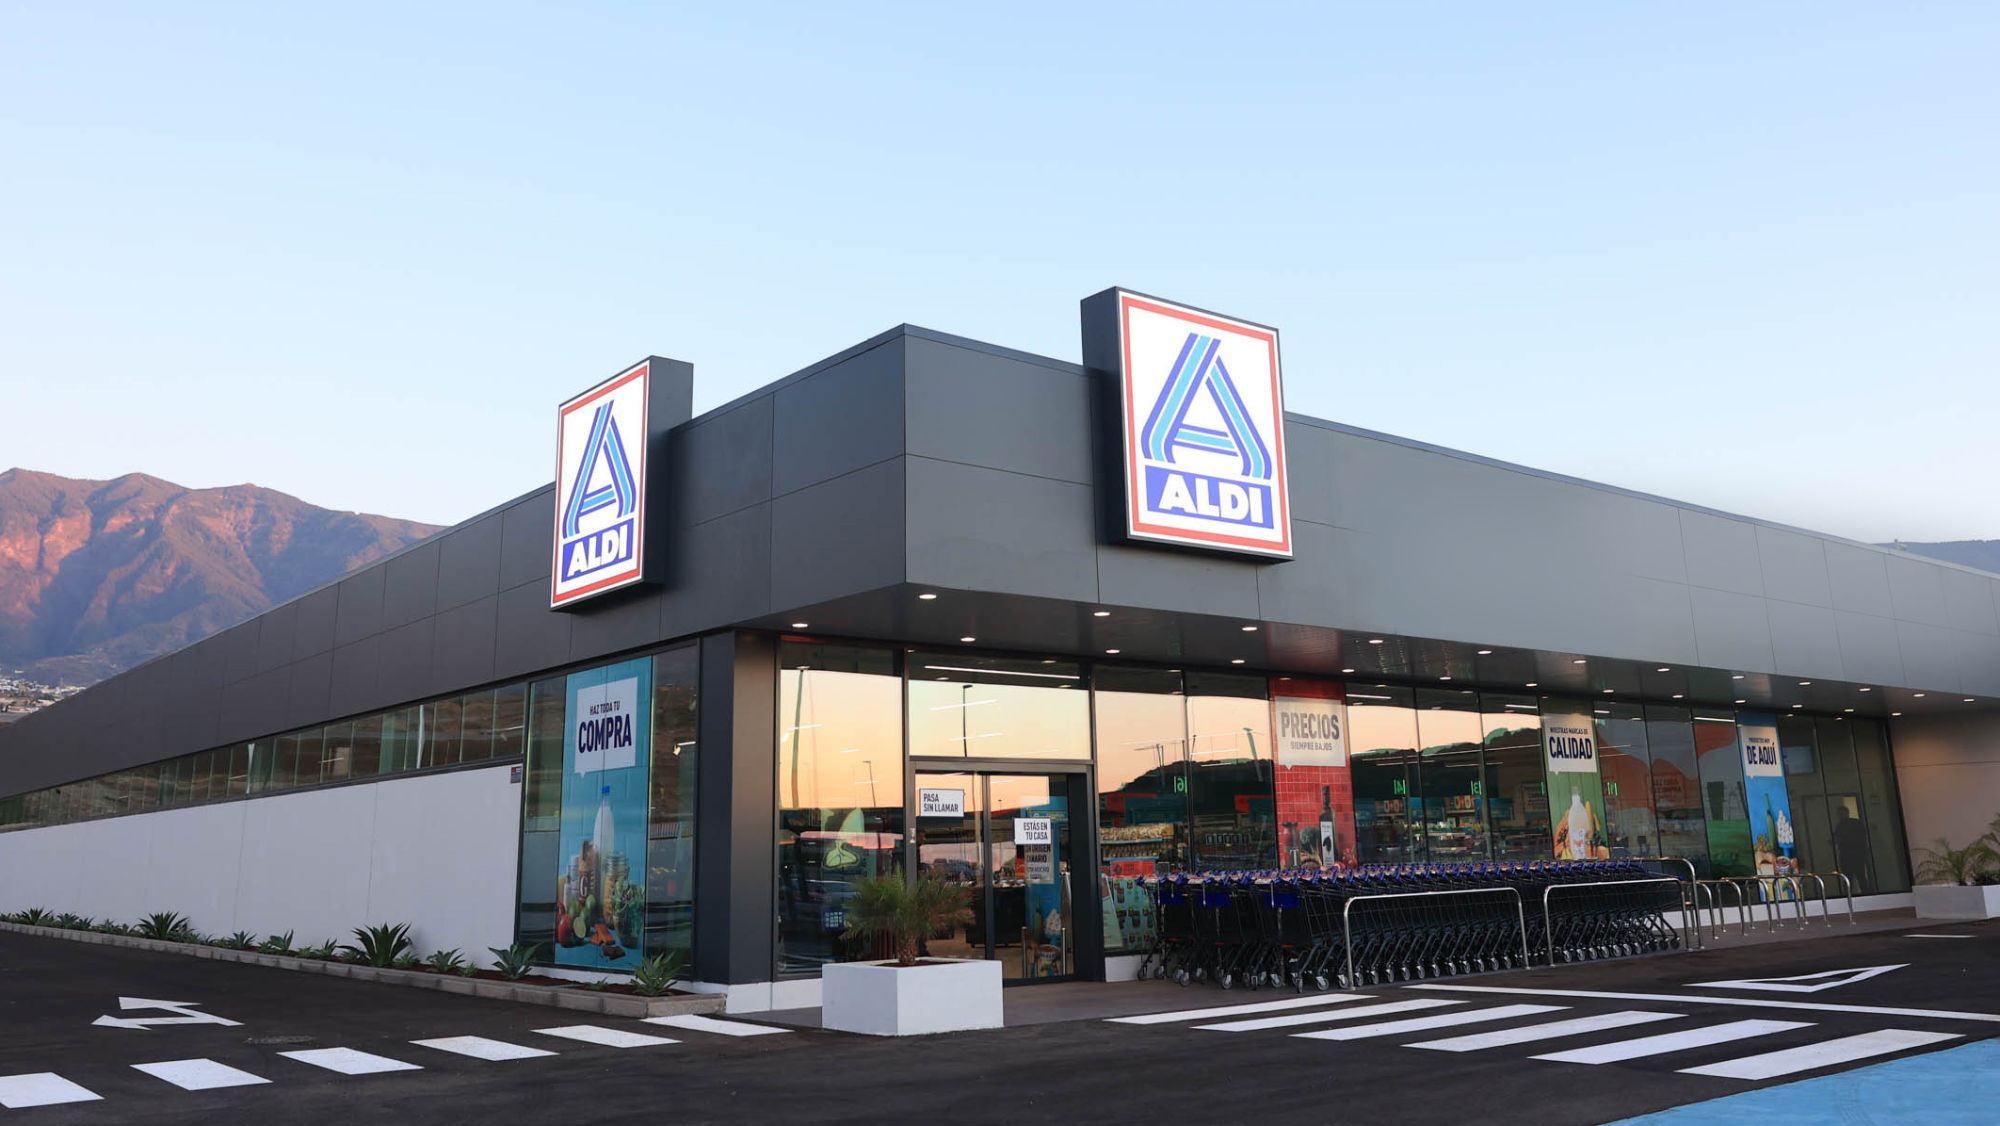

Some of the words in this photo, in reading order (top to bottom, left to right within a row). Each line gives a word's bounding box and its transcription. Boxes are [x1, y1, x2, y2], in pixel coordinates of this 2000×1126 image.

[1158, 473, 1263, 523] ALDI
[566, 524, 628, 577] ALDI
[590, 703, 599, 715] HAZ
[600, 701, 612, 713] TODA
[613, 700, 621, 711] TU
[578, 713, 632, 754] COMPRA
[1280, 711, 1339, 740] PRECIOS
[1290, 741, 1313, 750] SIEMPRE
[1315, 742, 1332, 751] BAJOS
[1549, 736, 1592, 759] CALIDAD
[1746, 745, 1758, 764] DE
[1758, 742, 1777, 765] AQUÍ
[923, 793, 939, 802] PASA
[923, 803, 933, 812] SIN
[934, 803, 959, 812] LLAMAR
[1023, 820, 1040, 831] ESTÁS
[1040, 822, 1048, 831] EN
[1025, 831, 1033, 840] TU
[1033, 831, 1048, 840] CASA
